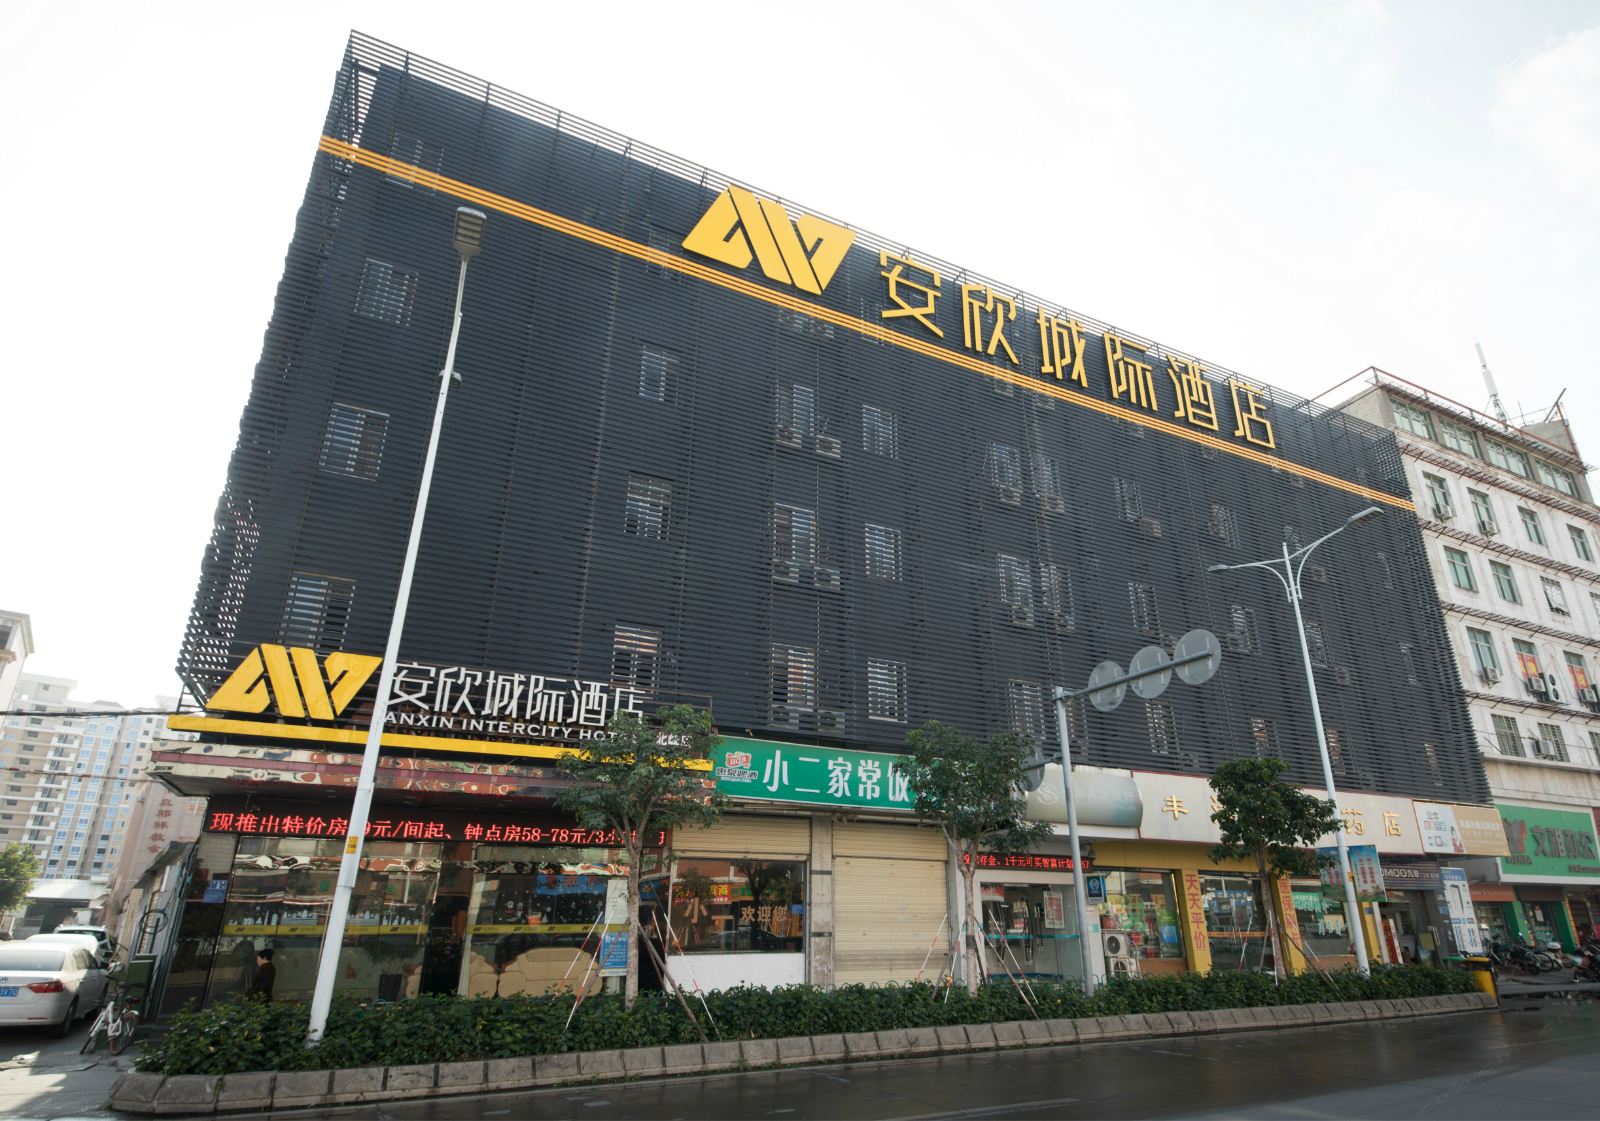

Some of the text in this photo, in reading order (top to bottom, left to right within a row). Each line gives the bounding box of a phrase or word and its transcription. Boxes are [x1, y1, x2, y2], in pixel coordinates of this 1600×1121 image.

[880, 249, 1276, 450] 安欣城际酒店
[387, 661, 646, 727] 安欣城际酒店
[384, 711, 638, 744] ANXIN INTERCITY HOT
[762, 749, 937, 803] 小二家常饭
[740, 905, 790, 922] 欢迎您
[1185, 873, 1207, 950] 天天平价
